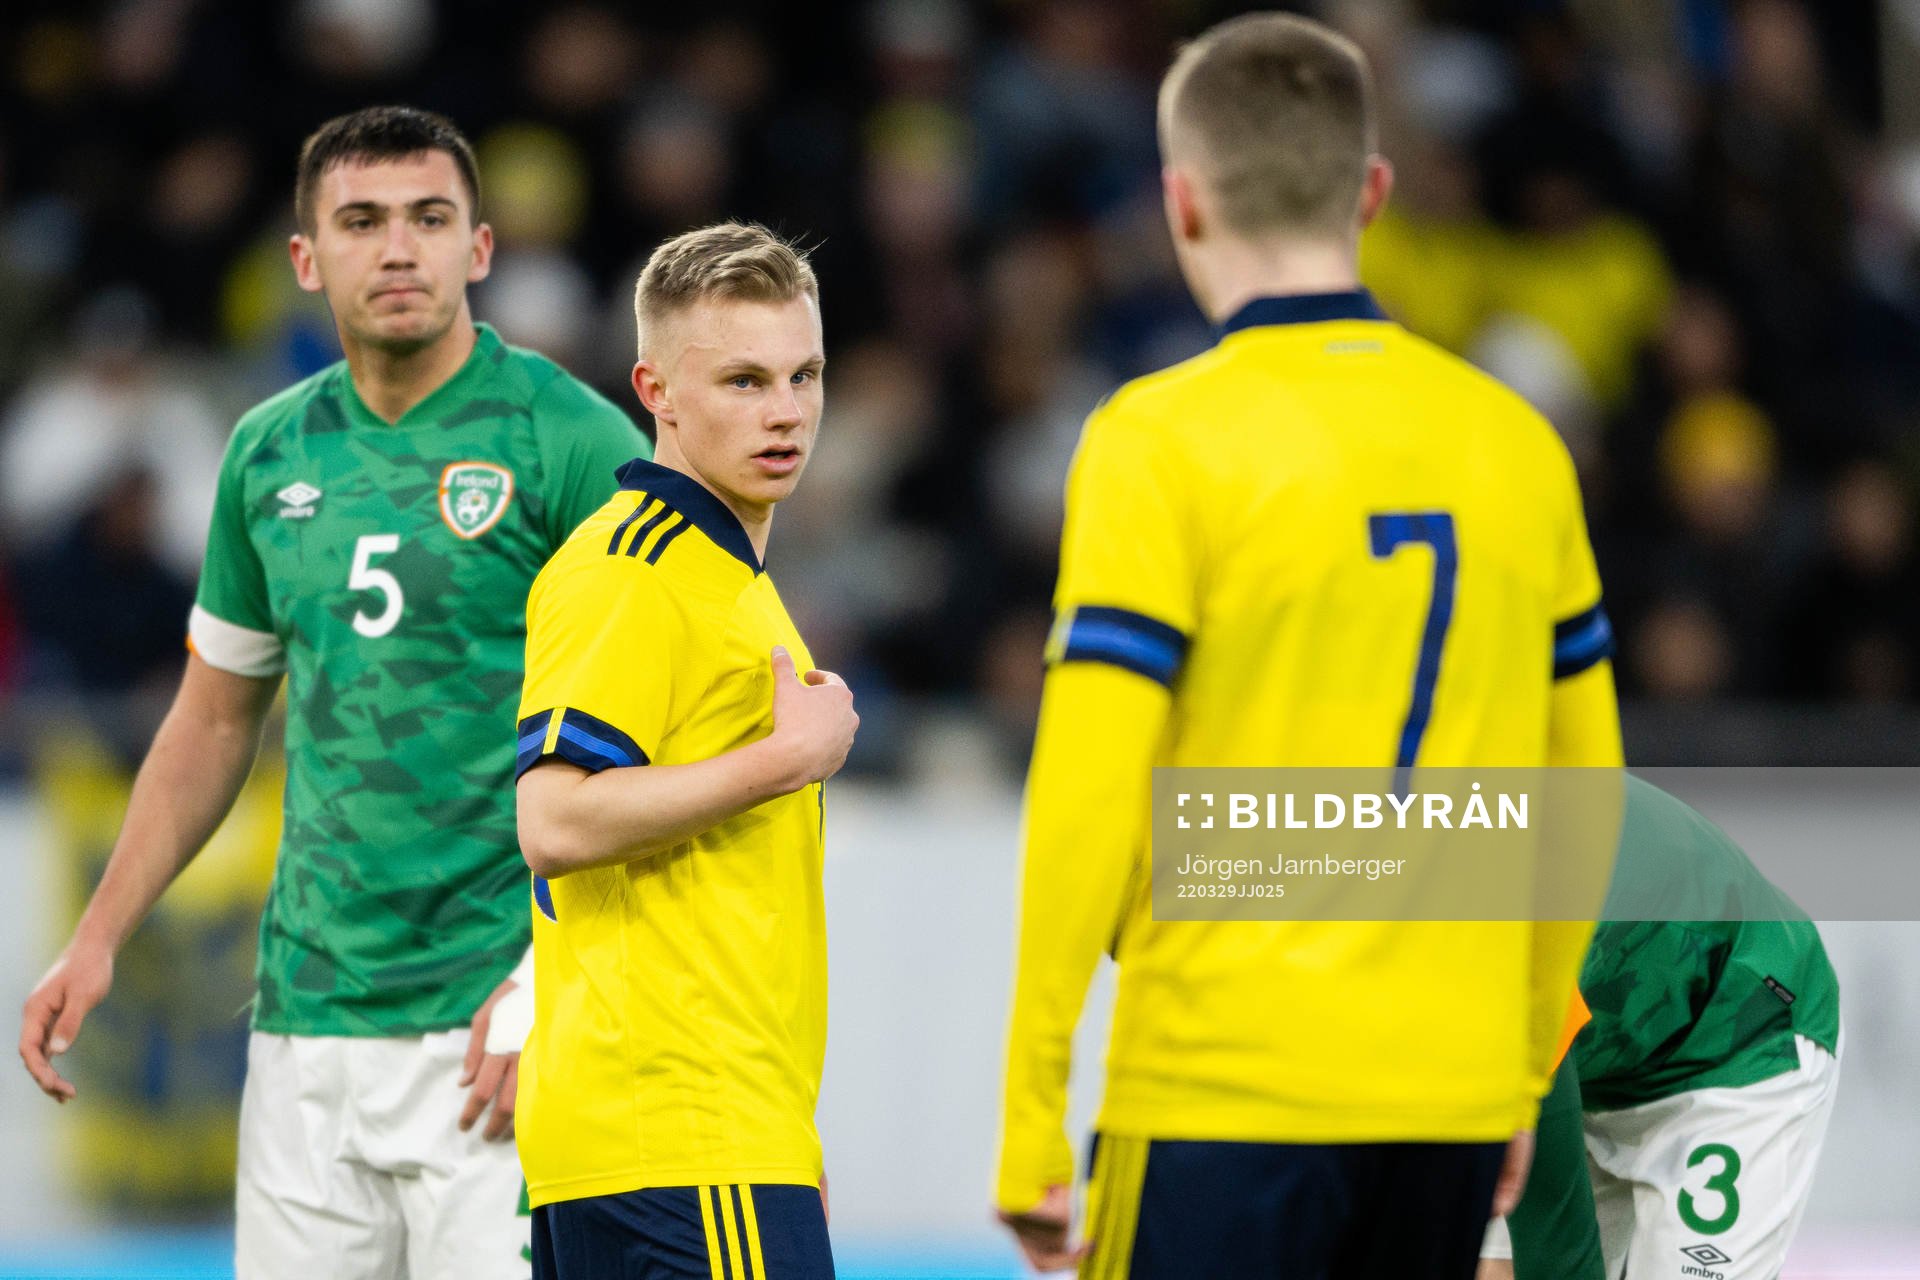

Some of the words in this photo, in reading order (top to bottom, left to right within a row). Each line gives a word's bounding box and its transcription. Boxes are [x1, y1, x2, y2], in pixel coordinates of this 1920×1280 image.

[348, 534, 404, 638] 5
[1367, 512, 1458, 812] 7
[1677, 1142, 1741, 1236] 3
[1681, 1265, 1724, 1280] umbro
